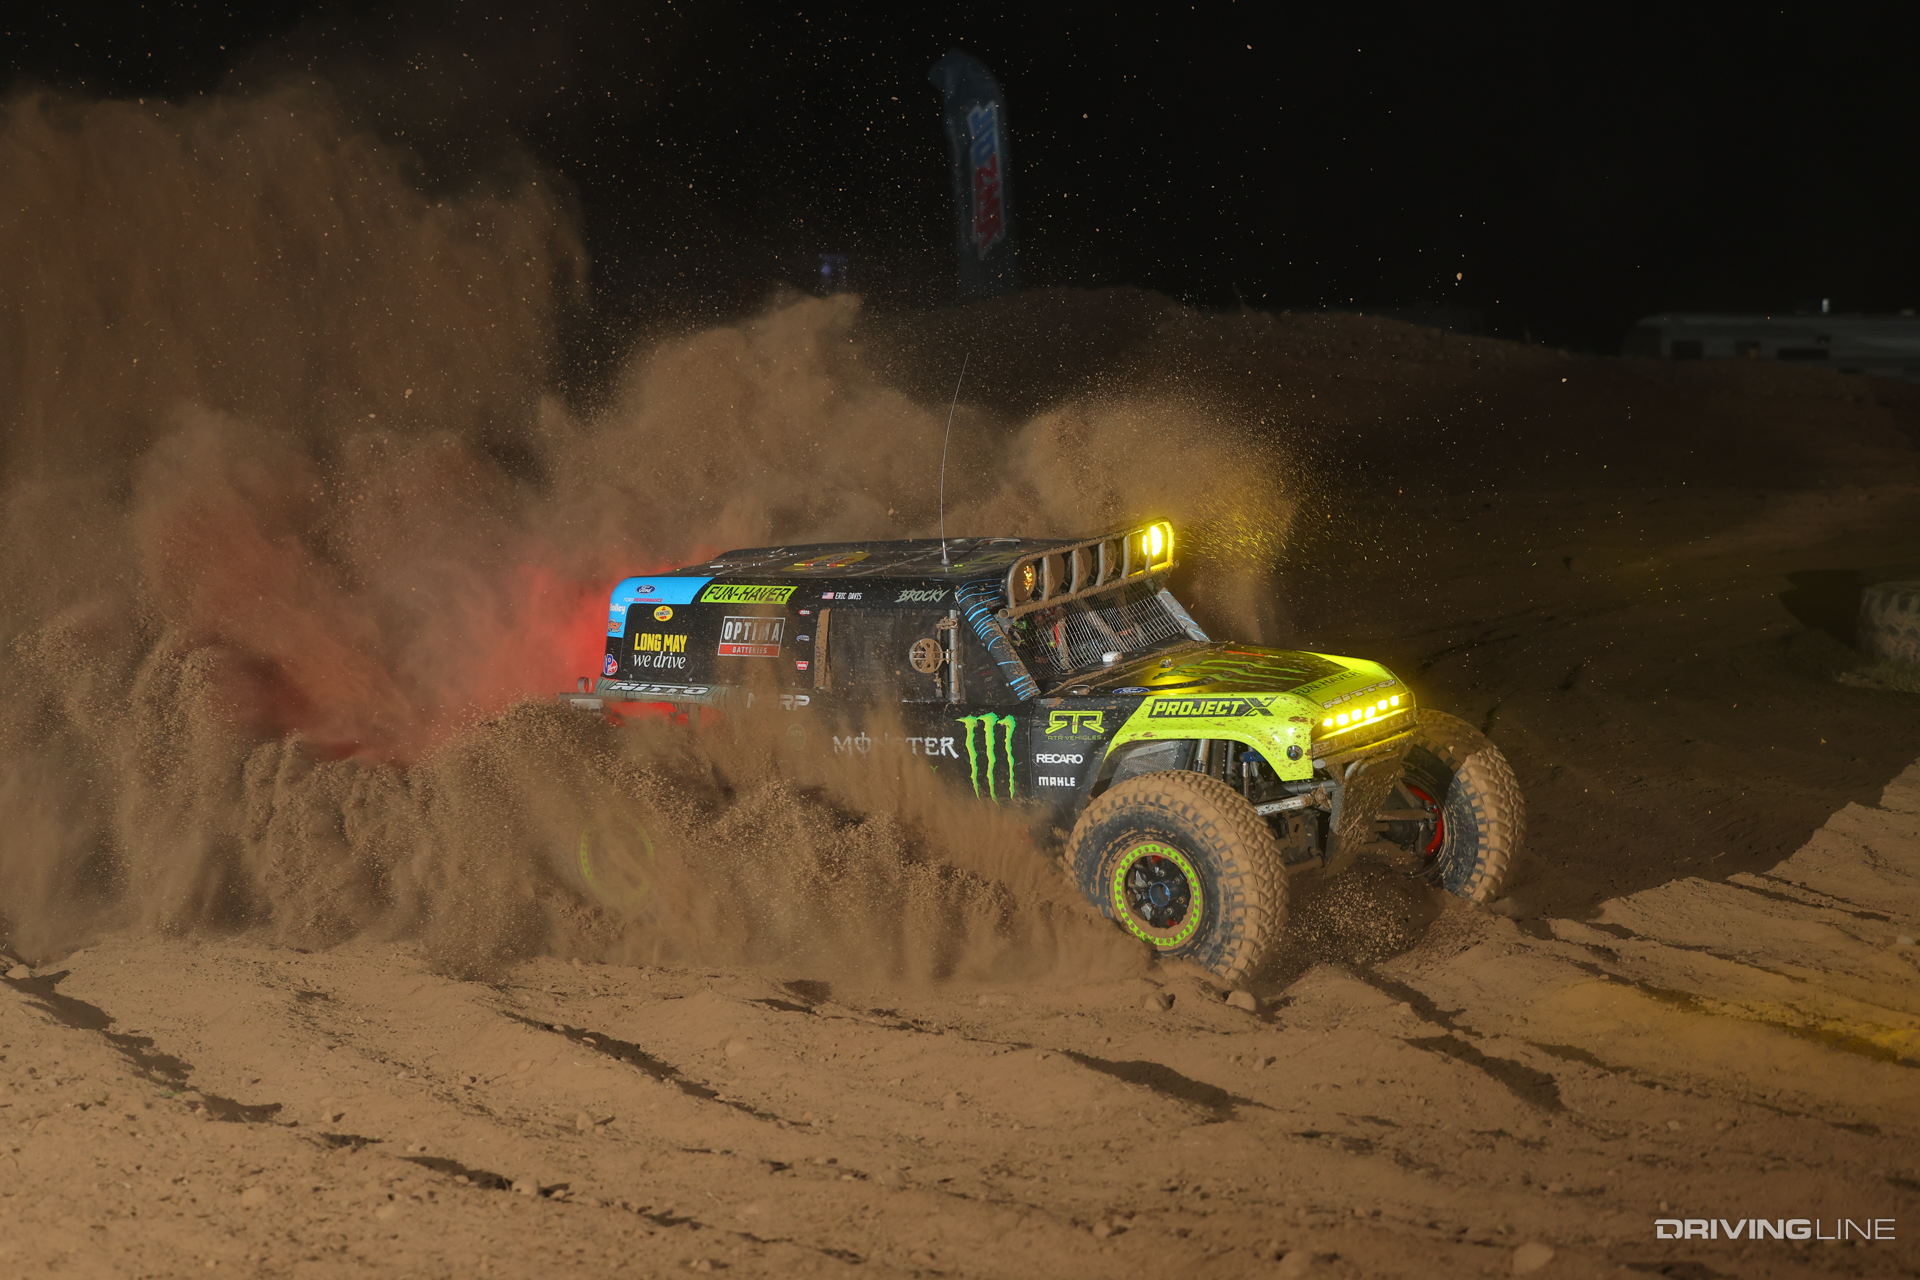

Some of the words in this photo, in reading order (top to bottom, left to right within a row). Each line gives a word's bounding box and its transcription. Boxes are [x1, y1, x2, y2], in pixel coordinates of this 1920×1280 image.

[704, 586, 791, 602] FUN-HAVER
[894, 588, 951, 603] BROCKY
[724, 621, 780, 642] OPTIMA
[634, 633, 662, 652] LONG
[663, 634, 688, 653] MAY
[732, 646, 767, 654] BATTERIES
[633, 653, 651, 668] we
[653, 651, 686, 670] drive
[609, 683, 709, 695] NITTO
[1290, 671, 1361, 695] FUN-HAVER
[1322, 679, 1396, 709] NITTO
[1151, 700, 1241, 716] PROJECT
[833, 731, 959, 759] MOTER
[1036, 753, 1083, 764] RECARO
[1038, 776, 1075, 787] MAHLE
